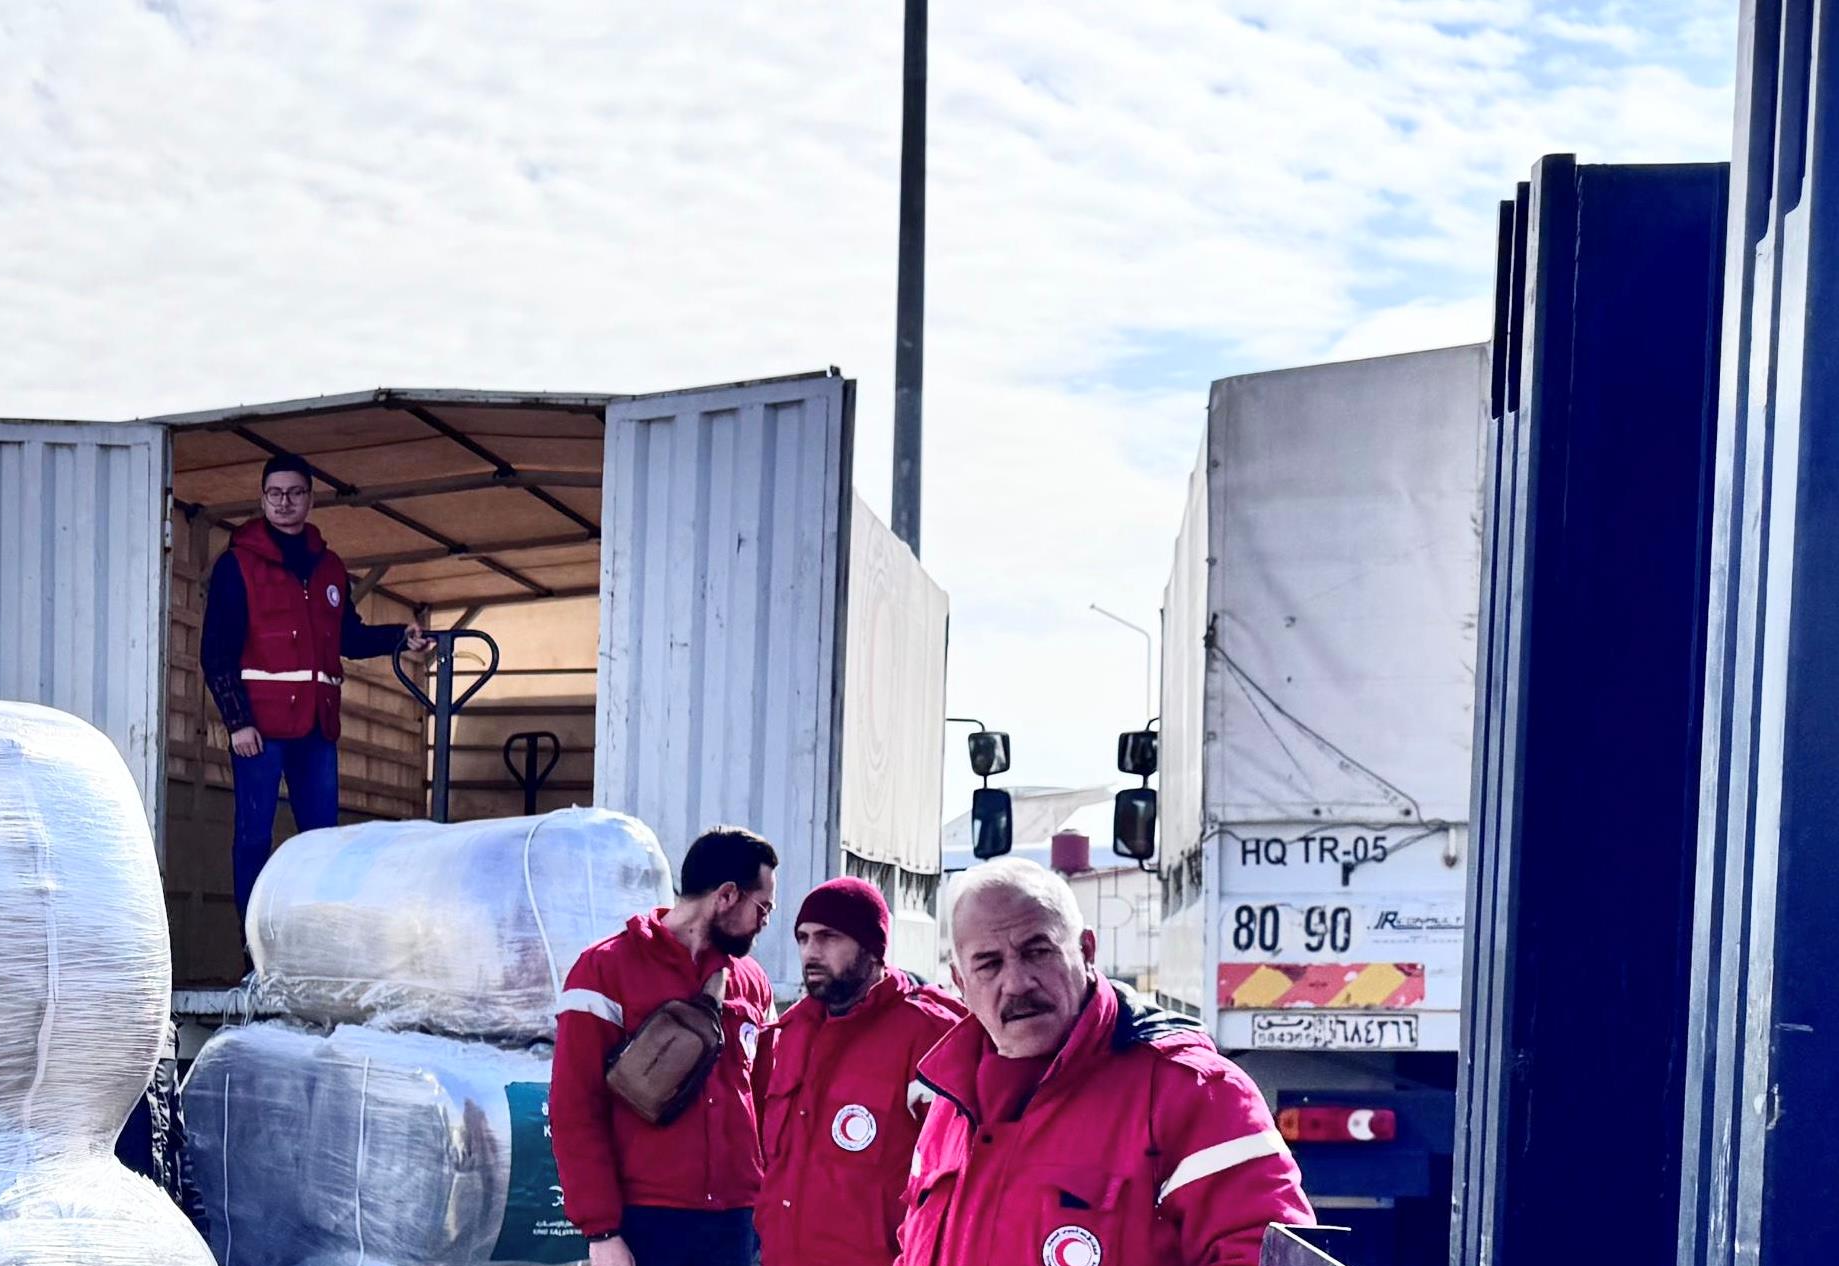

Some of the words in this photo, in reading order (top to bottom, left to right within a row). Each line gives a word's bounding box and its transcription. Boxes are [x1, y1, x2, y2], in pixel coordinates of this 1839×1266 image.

[1241, 838, 1287, 866] HQ
[1299, 836, 1389, 864] TR-05
[1232, 904, 1281, 953] 80
[1304, 905, 1352, 953] 90
